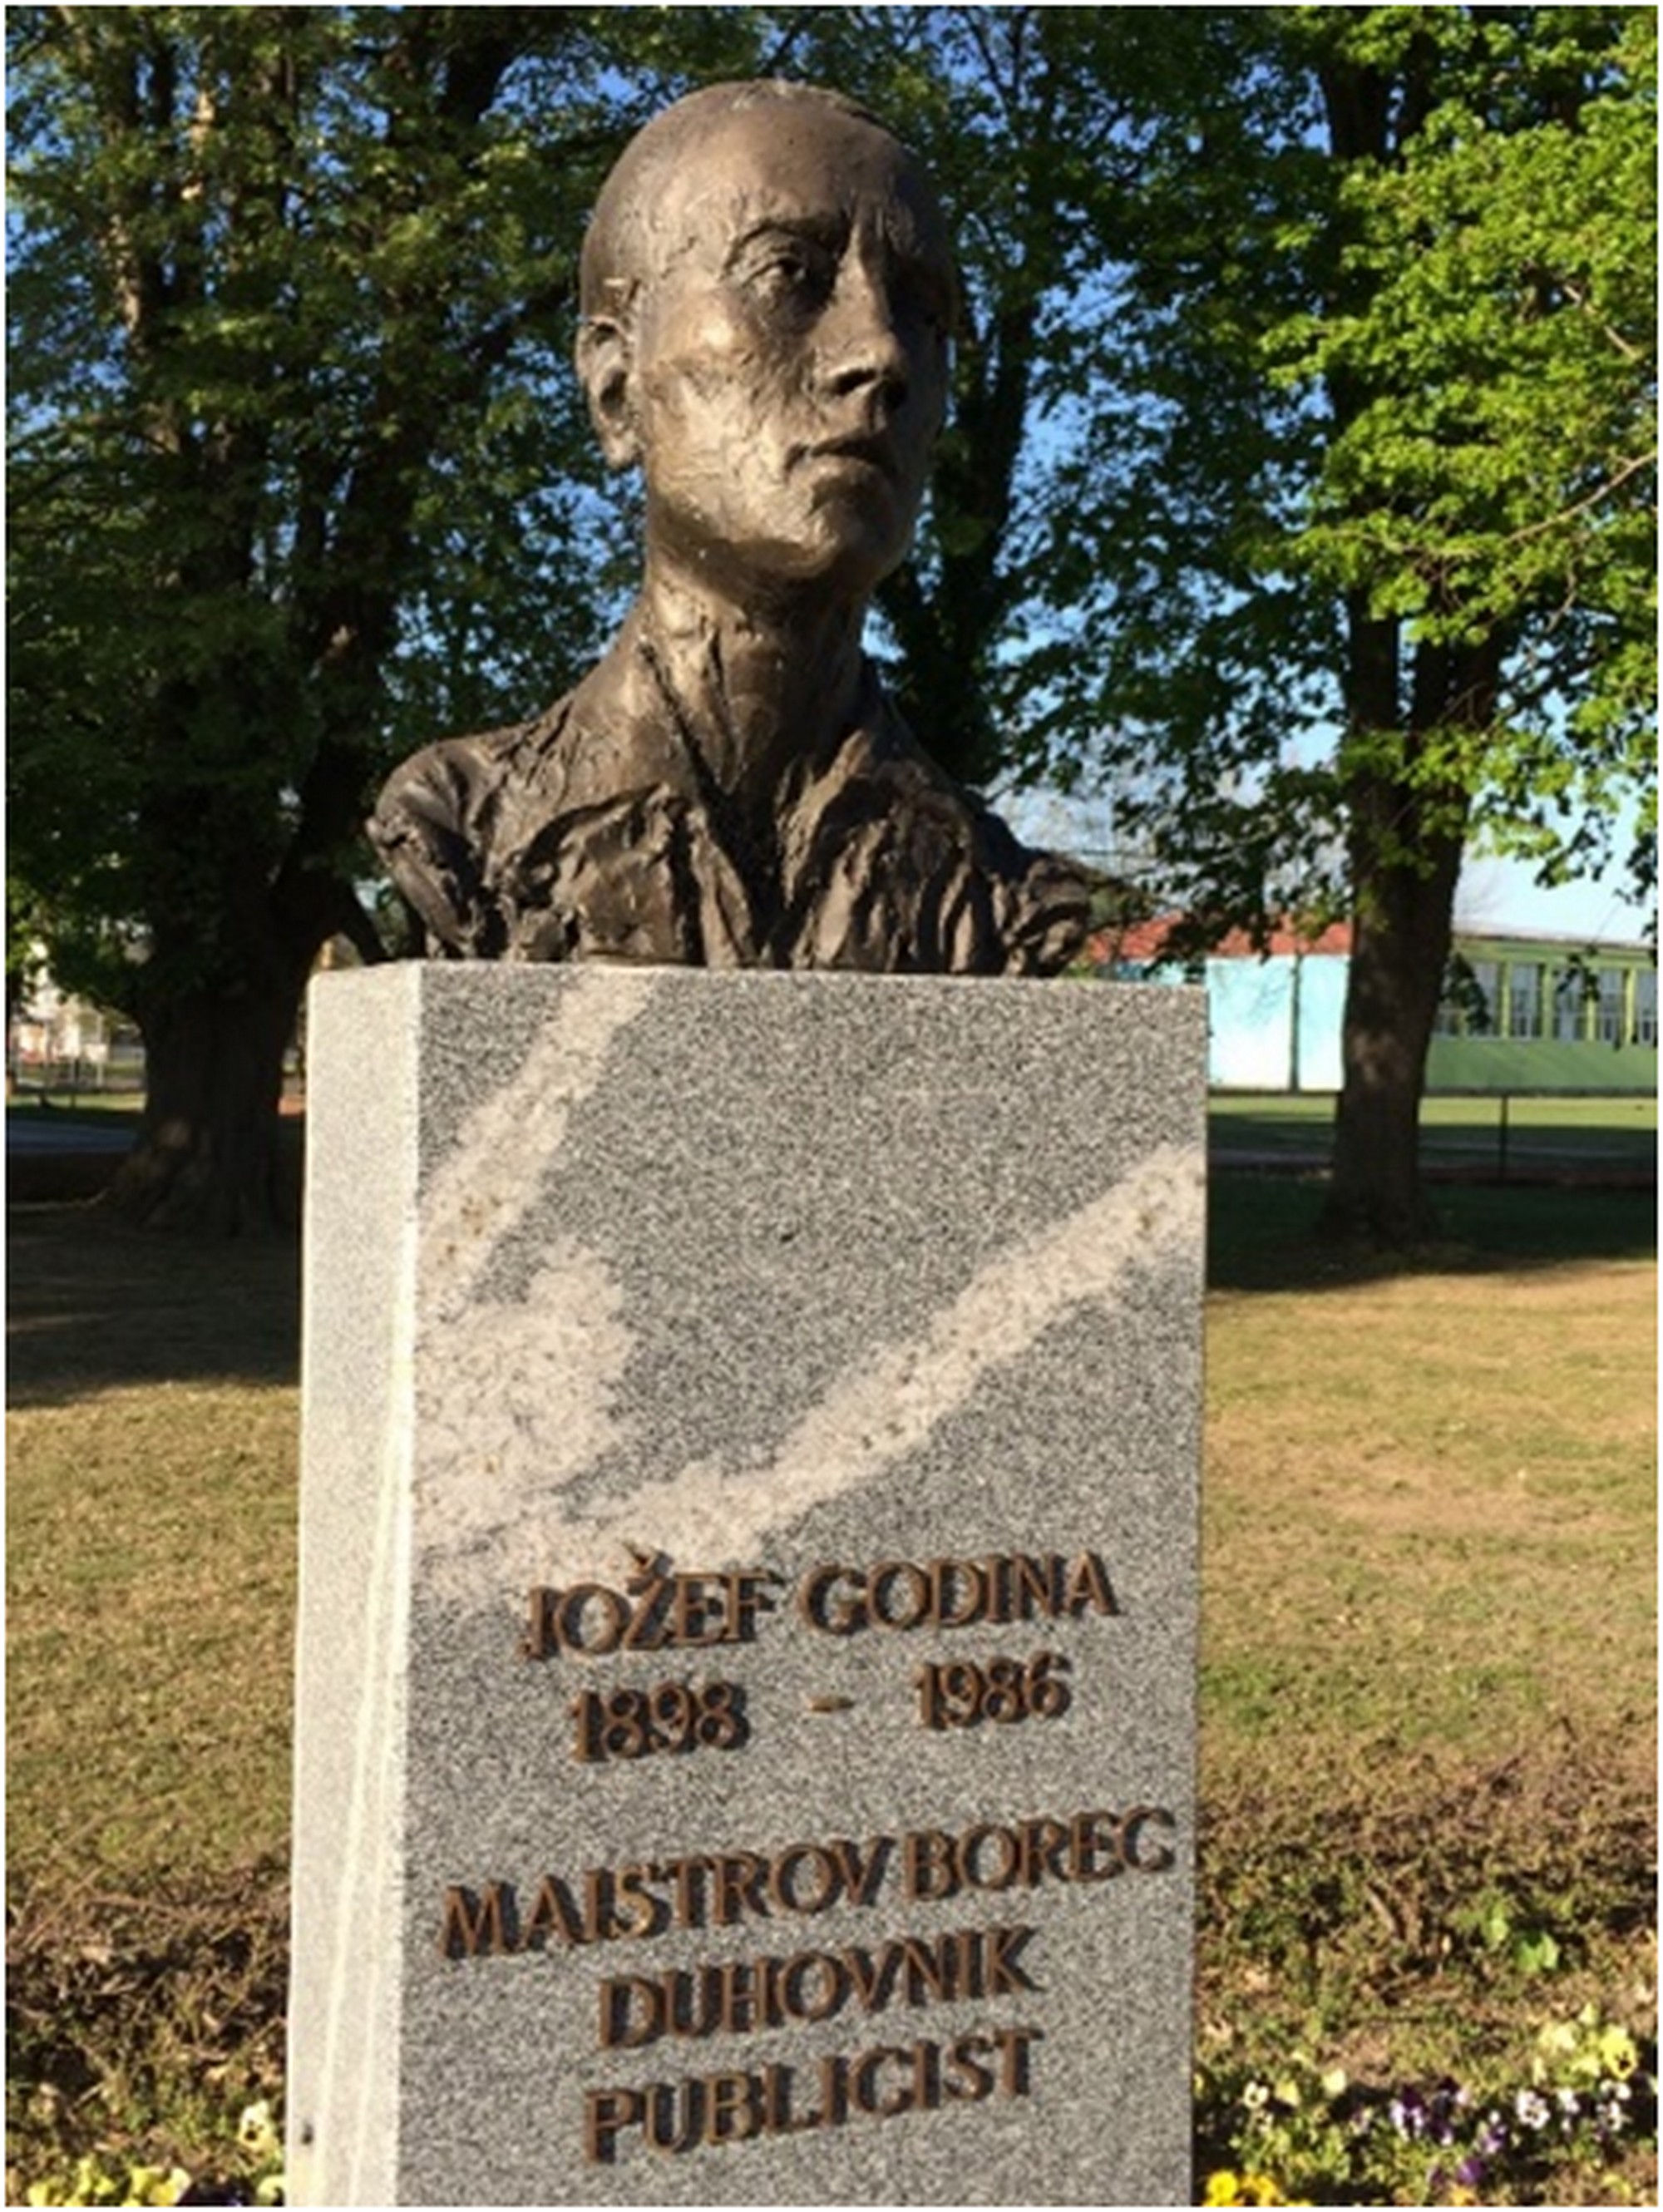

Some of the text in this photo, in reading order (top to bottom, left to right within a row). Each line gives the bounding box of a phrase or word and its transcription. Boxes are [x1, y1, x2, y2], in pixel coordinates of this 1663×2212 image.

[522, 1541, 1120, 1661] JOŽEF GODINA
[570, 1679, 748, 1763] 1898
[915, 1652, 1073, 1730] 1986
[440, 1805, 1177, 1960] MAISTROV BOREC
[597, 1925, 1044, 2050] DUHOVNIK
[583, 2027, 1044, 2162] PUBLICIST
